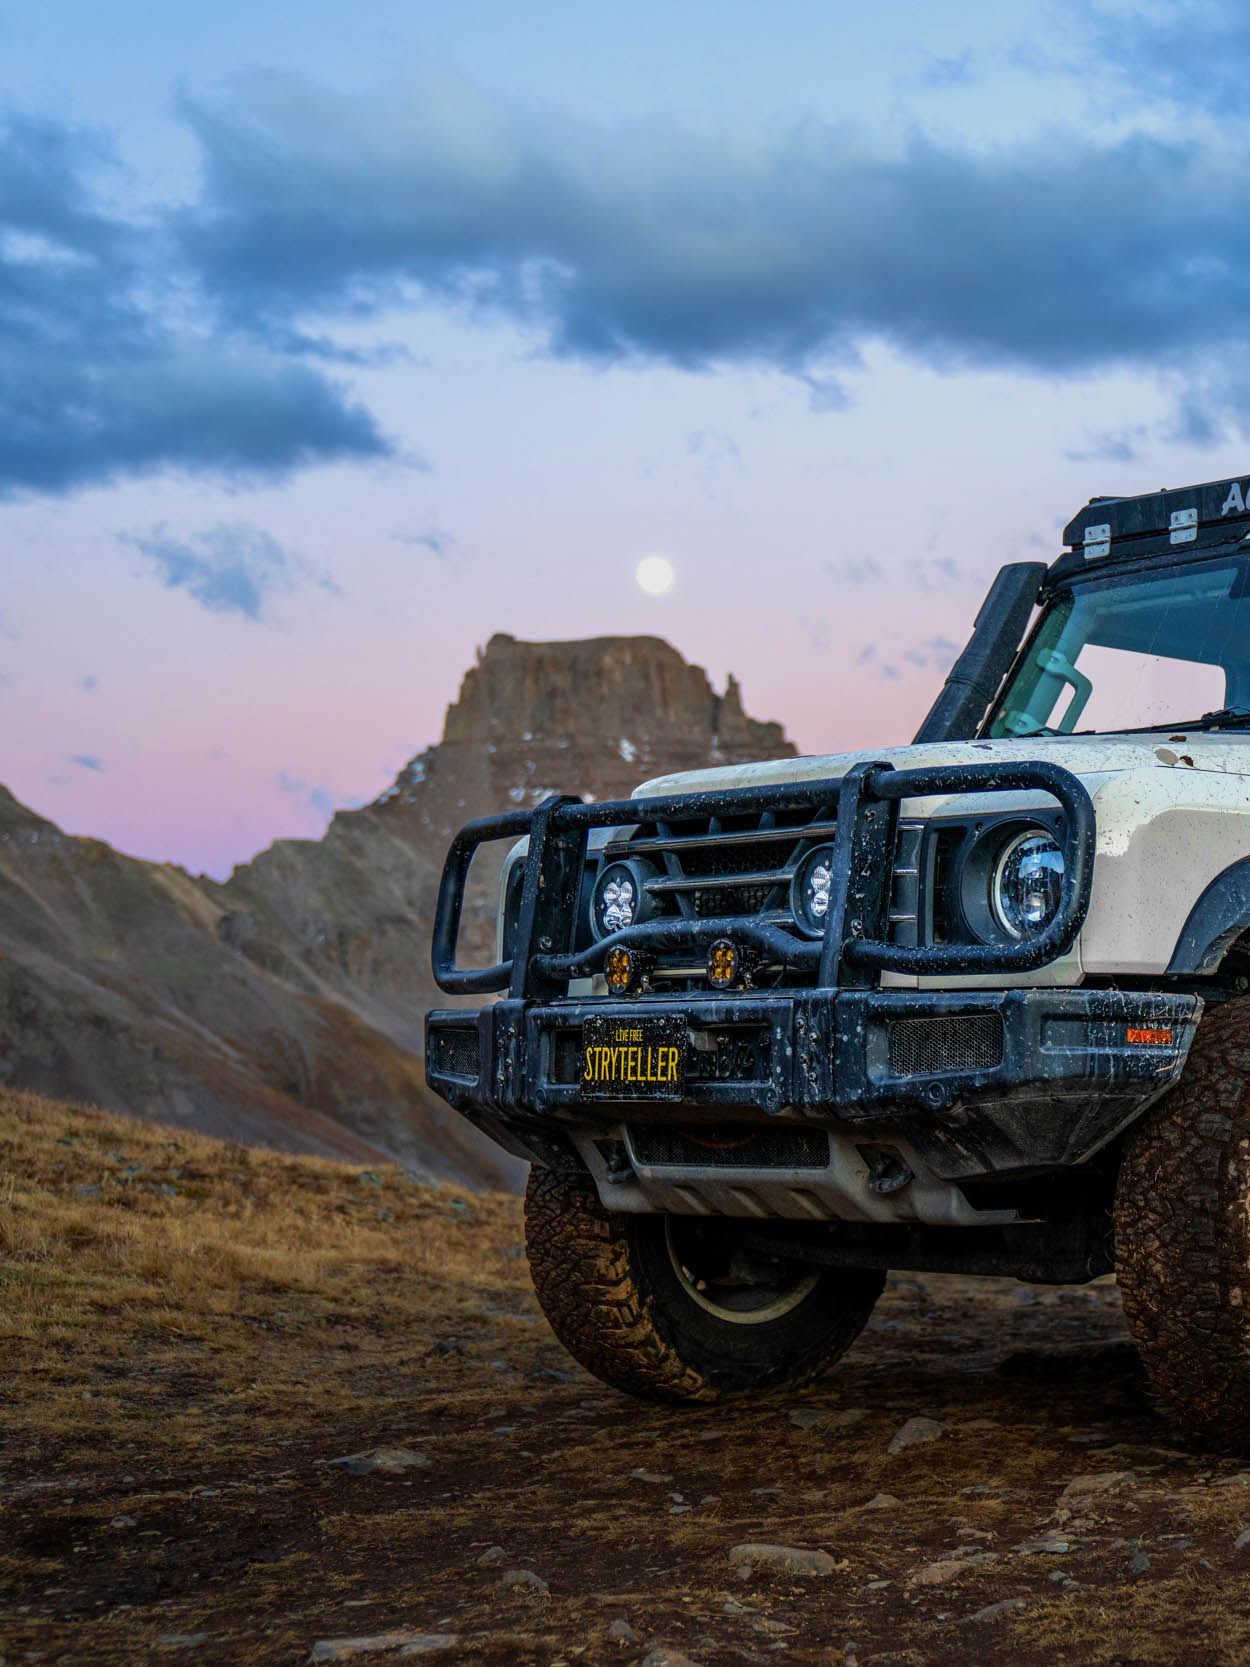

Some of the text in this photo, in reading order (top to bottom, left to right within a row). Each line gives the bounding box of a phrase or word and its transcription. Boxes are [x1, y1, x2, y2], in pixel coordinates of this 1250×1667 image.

[615, 1029, 643, 1042] LIVE FREE
[584, 1047, 679, 1081] STRYTELLER
